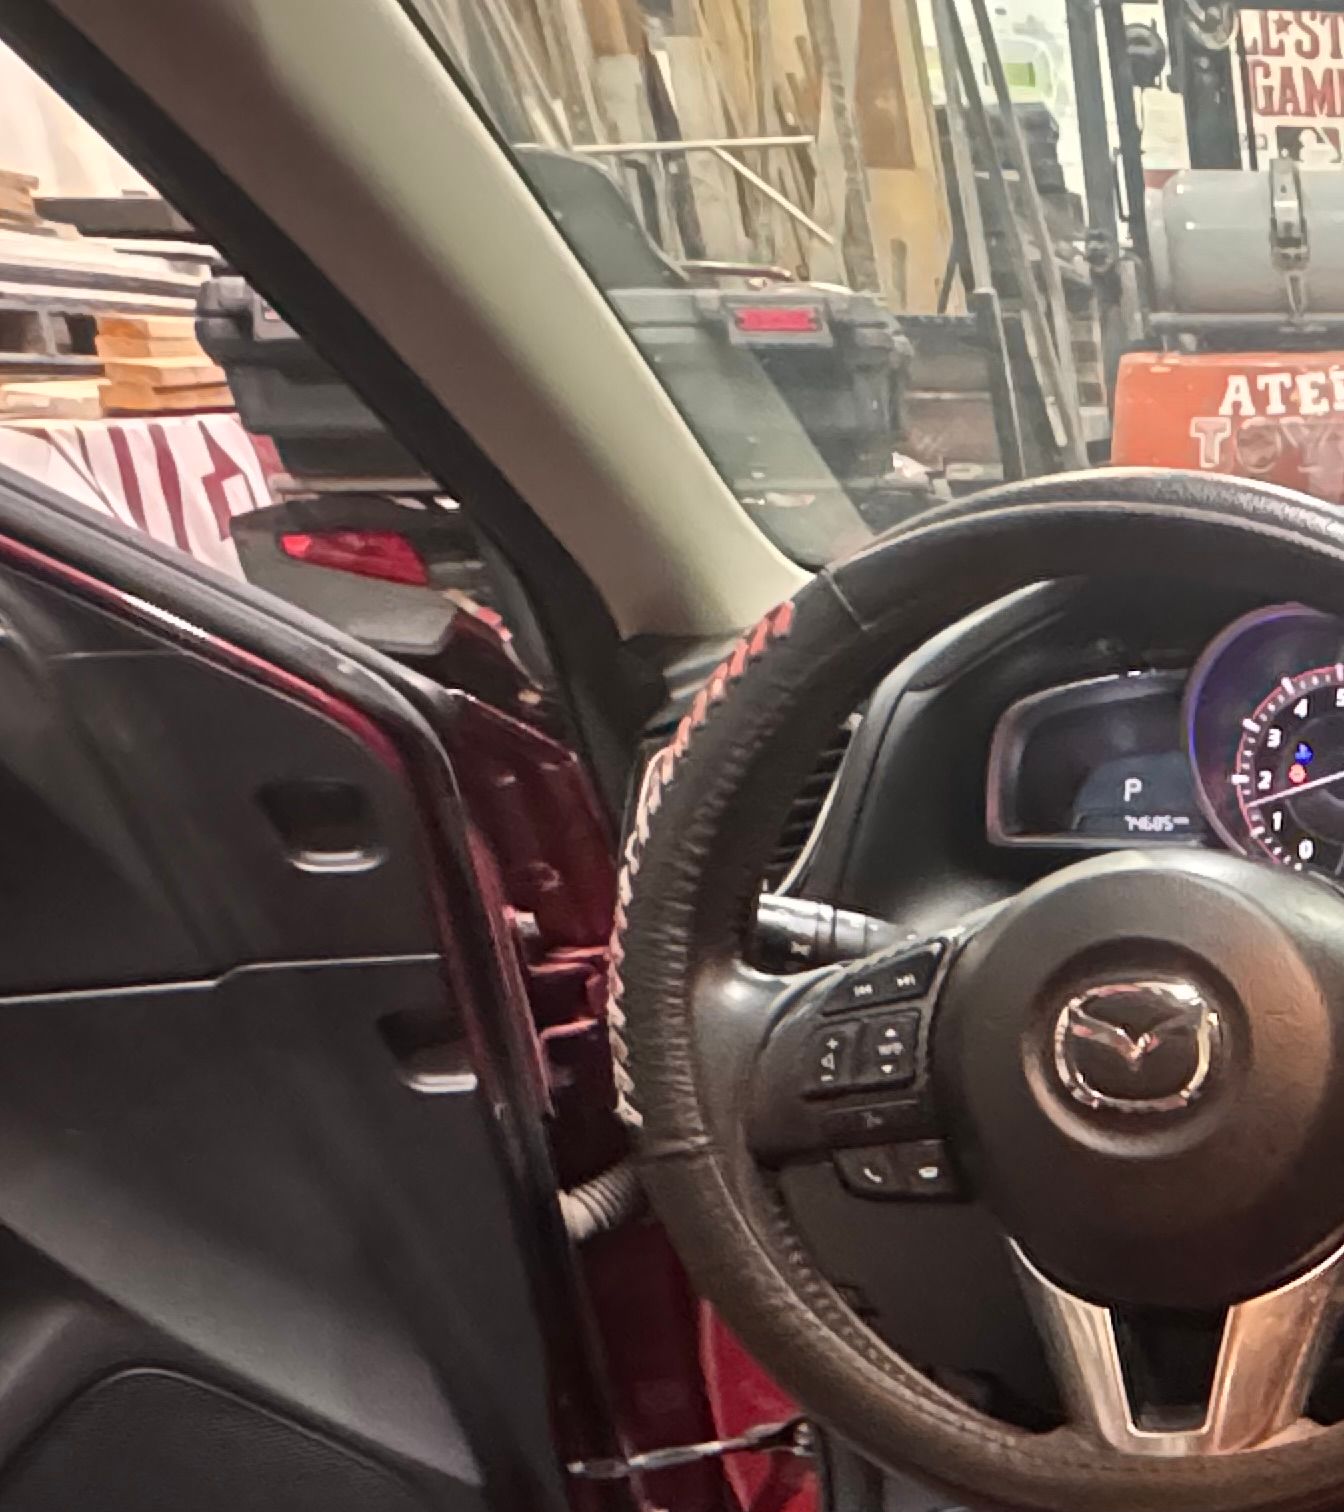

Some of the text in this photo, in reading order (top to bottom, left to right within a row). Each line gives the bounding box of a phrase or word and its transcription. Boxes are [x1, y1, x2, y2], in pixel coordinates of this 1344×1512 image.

[1293, 698, 1308, 718] 4
[1266, 728, 1282, 748] 3
[1123, 777, 1142, 802] P
[1257, 770, 1272, 790] 2
[1272, 811, 1283, 832] 1
[1298, 839, 1314, 860] 0
